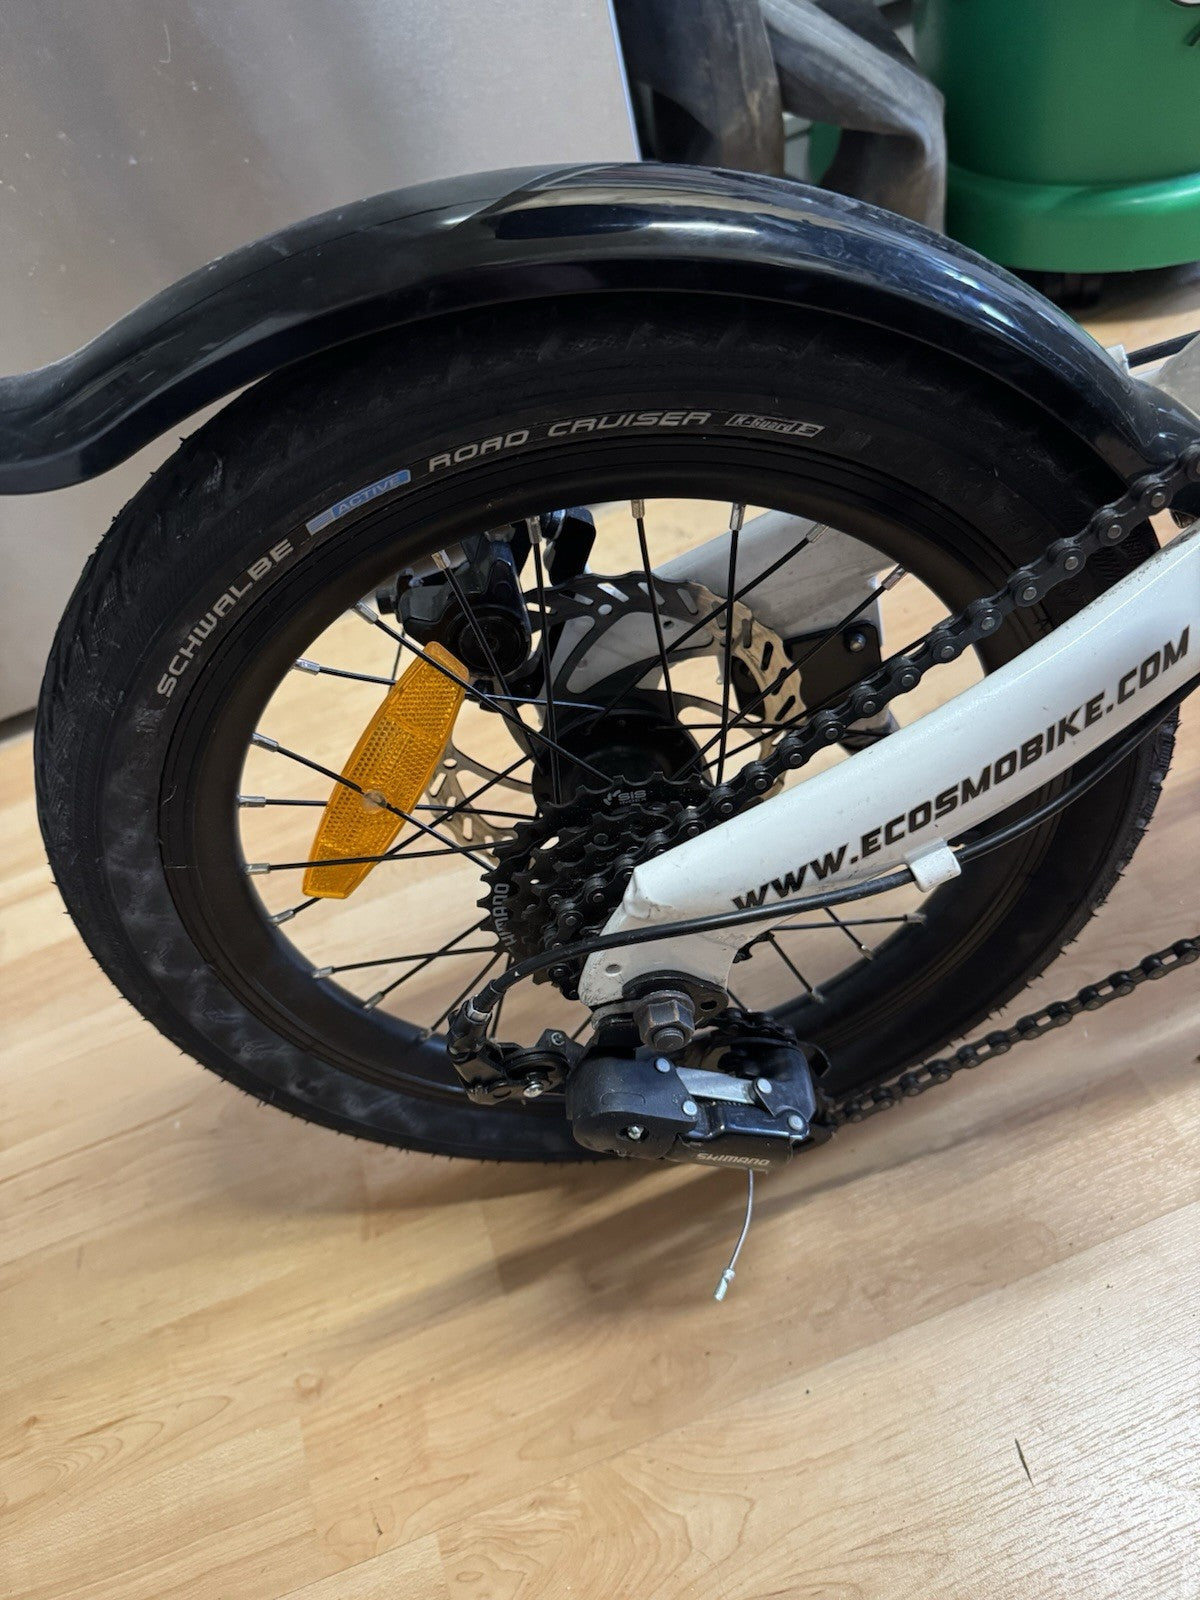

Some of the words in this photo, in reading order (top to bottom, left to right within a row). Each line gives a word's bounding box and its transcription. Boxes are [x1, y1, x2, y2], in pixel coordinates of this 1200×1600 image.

[156, 538, 294, 698] SCHWALBE
[337, 474, 400, 517] ACTIVE
[428, 429, 529, 473] ROAD
[547, 410, 712, 438] CRUISER
[731, 624, 1191, 910] WWW.ECOSMOBIKE.COM
[491, 882, 517, 946] HIMANO
[696, 1152, 770, 1166] SHIMANO
